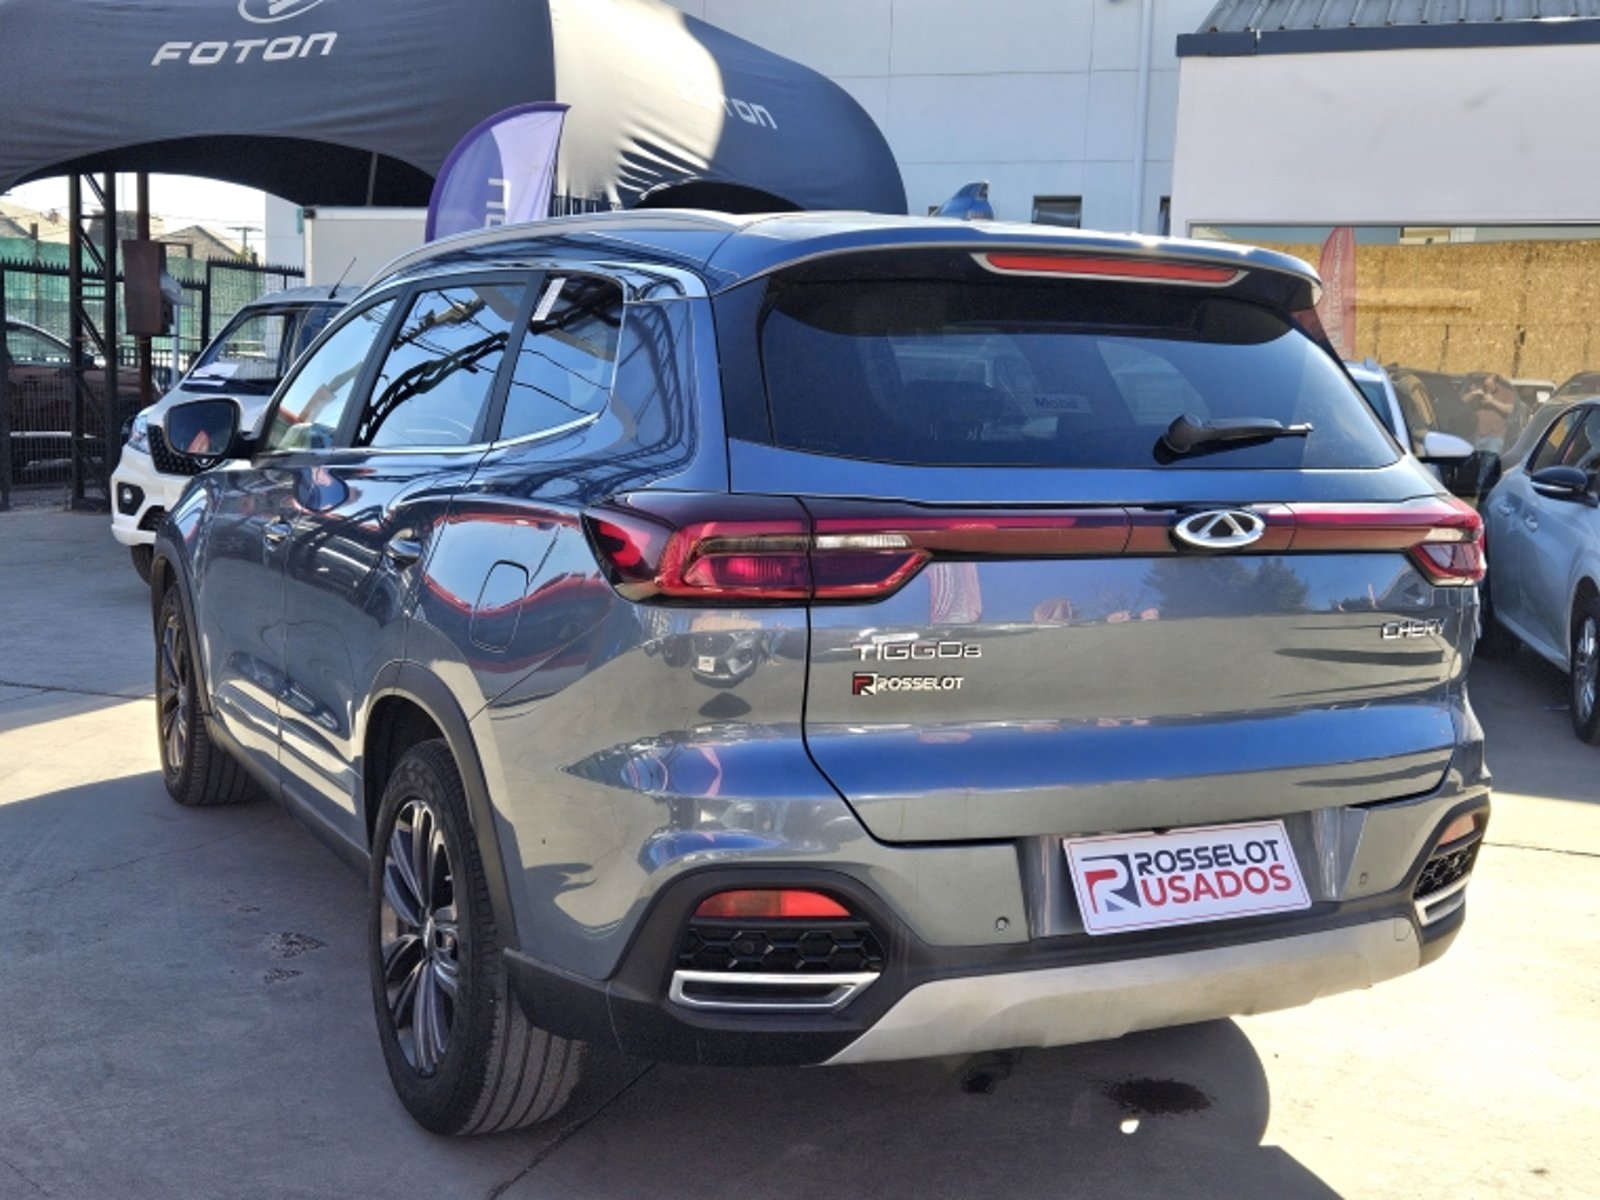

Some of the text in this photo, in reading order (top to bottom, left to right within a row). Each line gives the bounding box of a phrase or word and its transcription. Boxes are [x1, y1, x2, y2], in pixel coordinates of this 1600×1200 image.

[151, 32, 337, 66] FOTON
[1382, 619, 1447, 639] CHERY
[877, 676, 964, 691] ROSSELOT
[1135, 840, 1279, 876] ROSSELOT
[1141, 864, 1292, 906] USADOS
